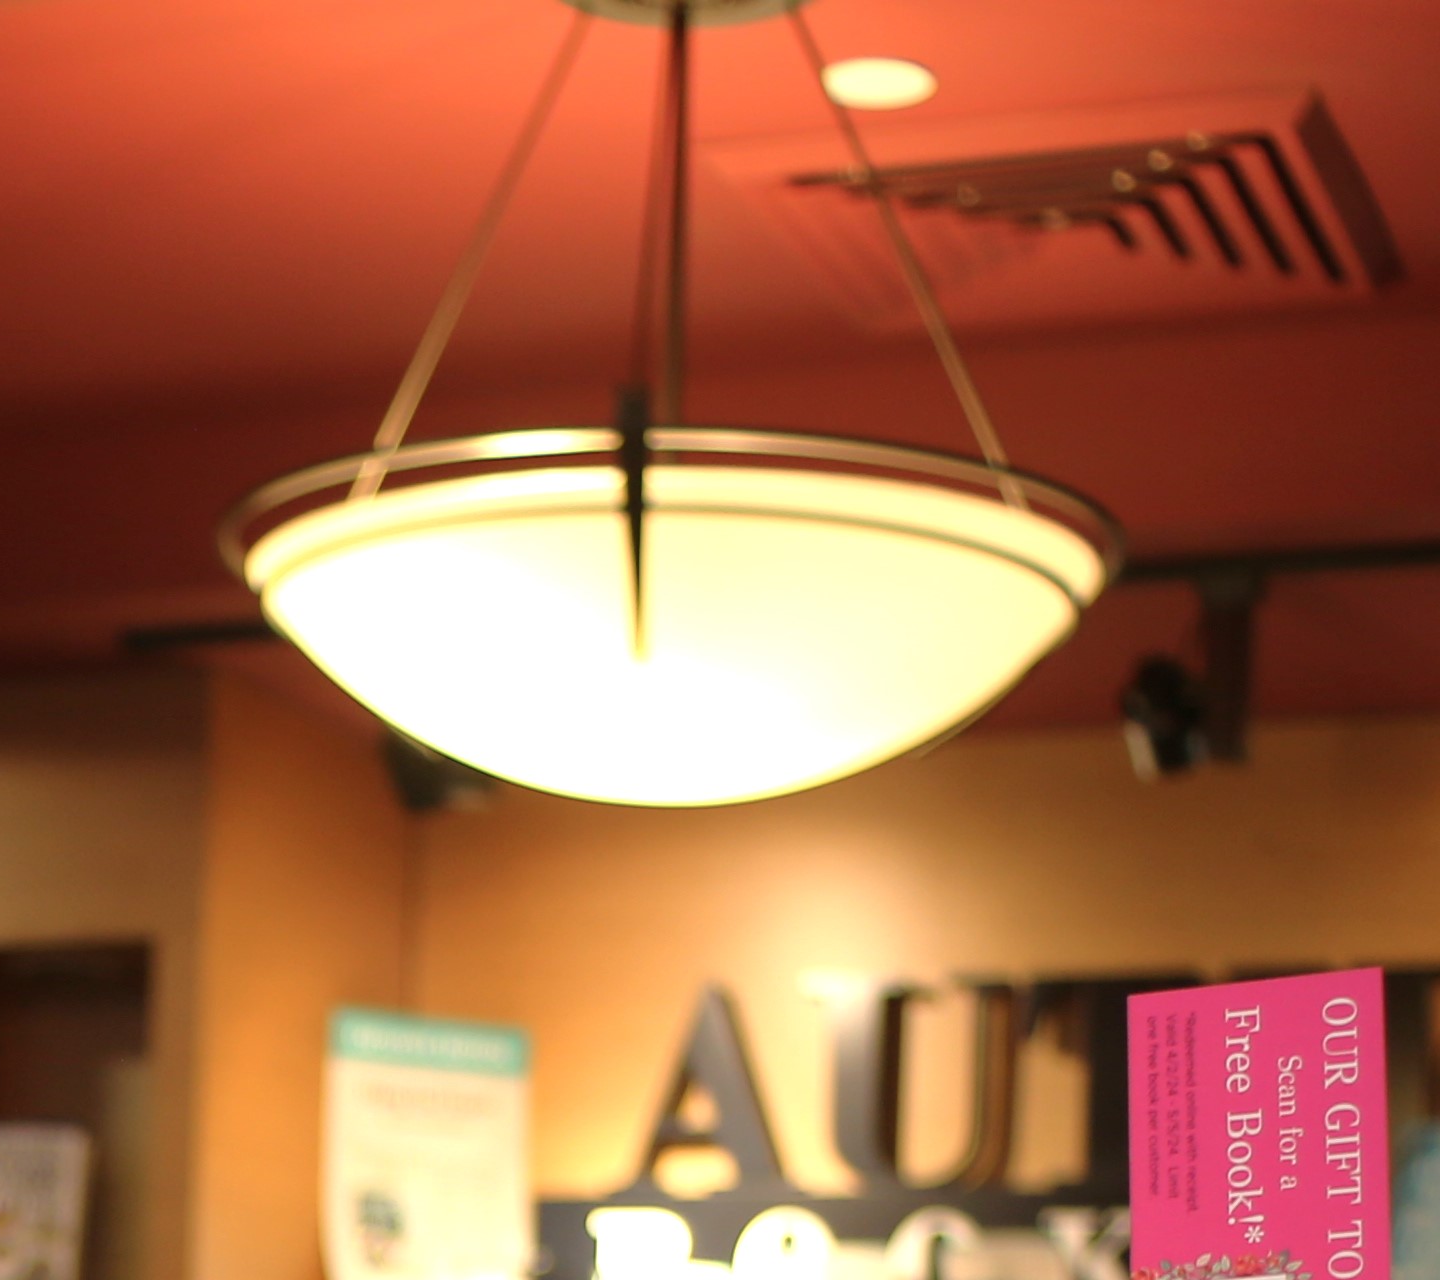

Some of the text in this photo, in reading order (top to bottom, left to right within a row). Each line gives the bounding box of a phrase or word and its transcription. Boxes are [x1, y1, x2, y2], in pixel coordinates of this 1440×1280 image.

[1225, 1005, 1260, 1093] Free
[1322, 997, 1358, 1089] OUR
[1277, 1055, 1303, 1162] Scan for
[1324, 1104, 1362, 1203] GIFT
[1328, 1221, 1366, 1280] TO
